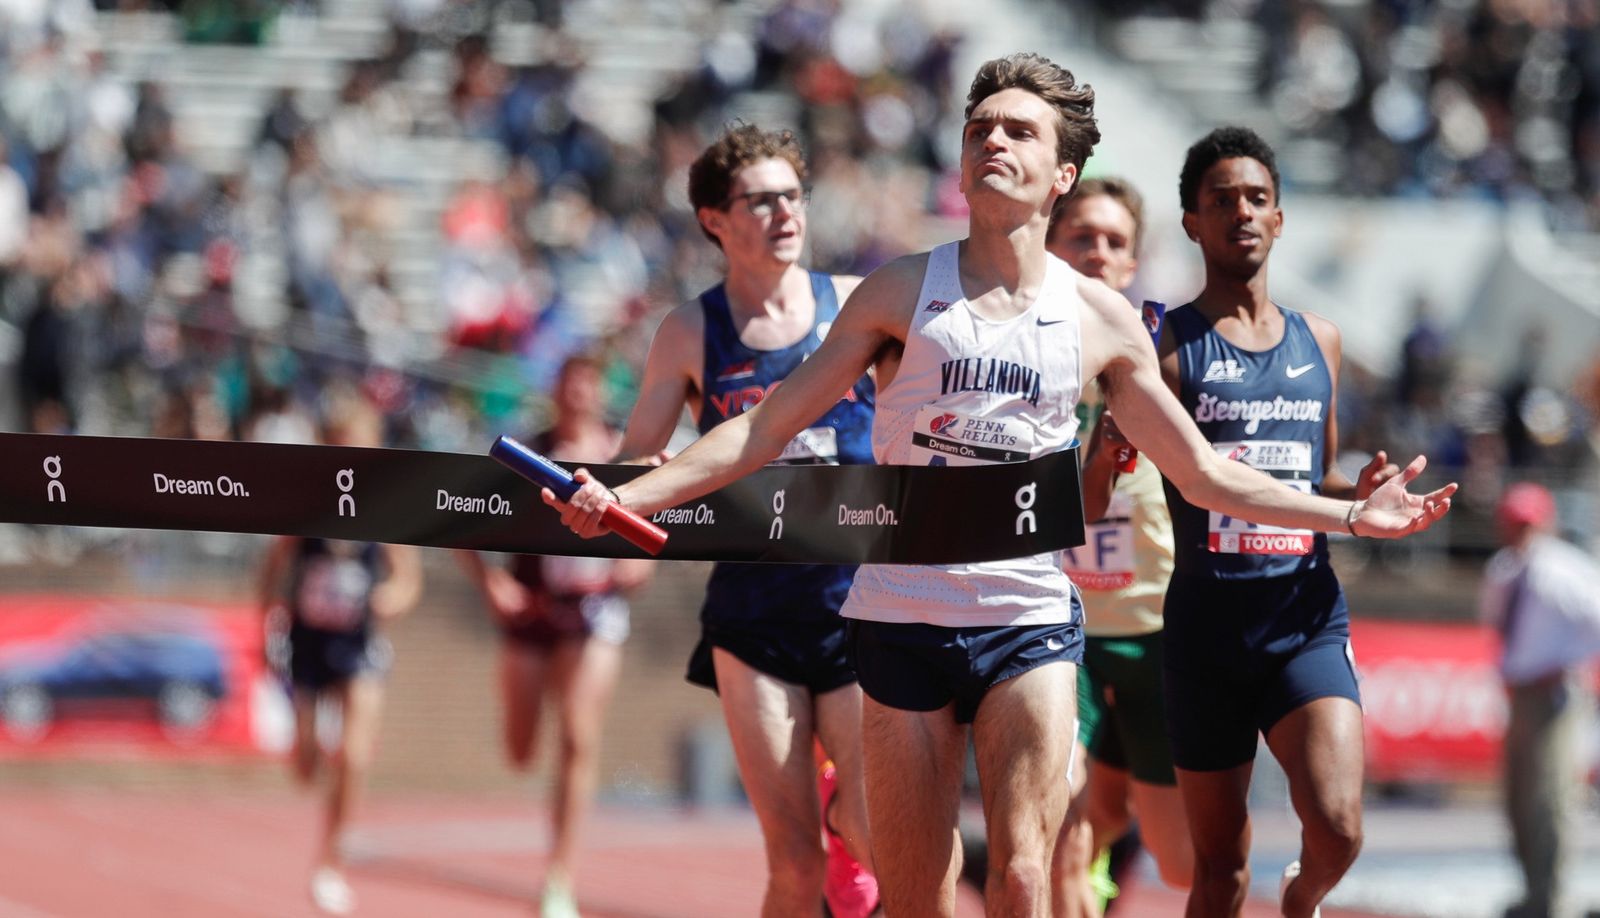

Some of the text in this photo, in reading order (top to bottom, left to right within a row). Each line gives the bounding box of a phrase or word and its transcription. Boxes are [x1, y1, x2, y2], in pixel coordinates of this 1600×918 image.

[941, 358, 1041, 408] VILLANOVA
[1195, 392, 1323, 435] Georgetown
[965, 419, 1006, 433] PENN
[929, 439, 976, 457] Dream On.
[960, 431, 1018, 446] RELAYS
[153, 473, 250, 497] Dream On.
[436, 489, 513, 516] Dream On.
[652, 503, 715, 525] Dream On.
[838, 503, 898, 526] Dream On.
[1243, 535, 1304, 552] TOYOTA
